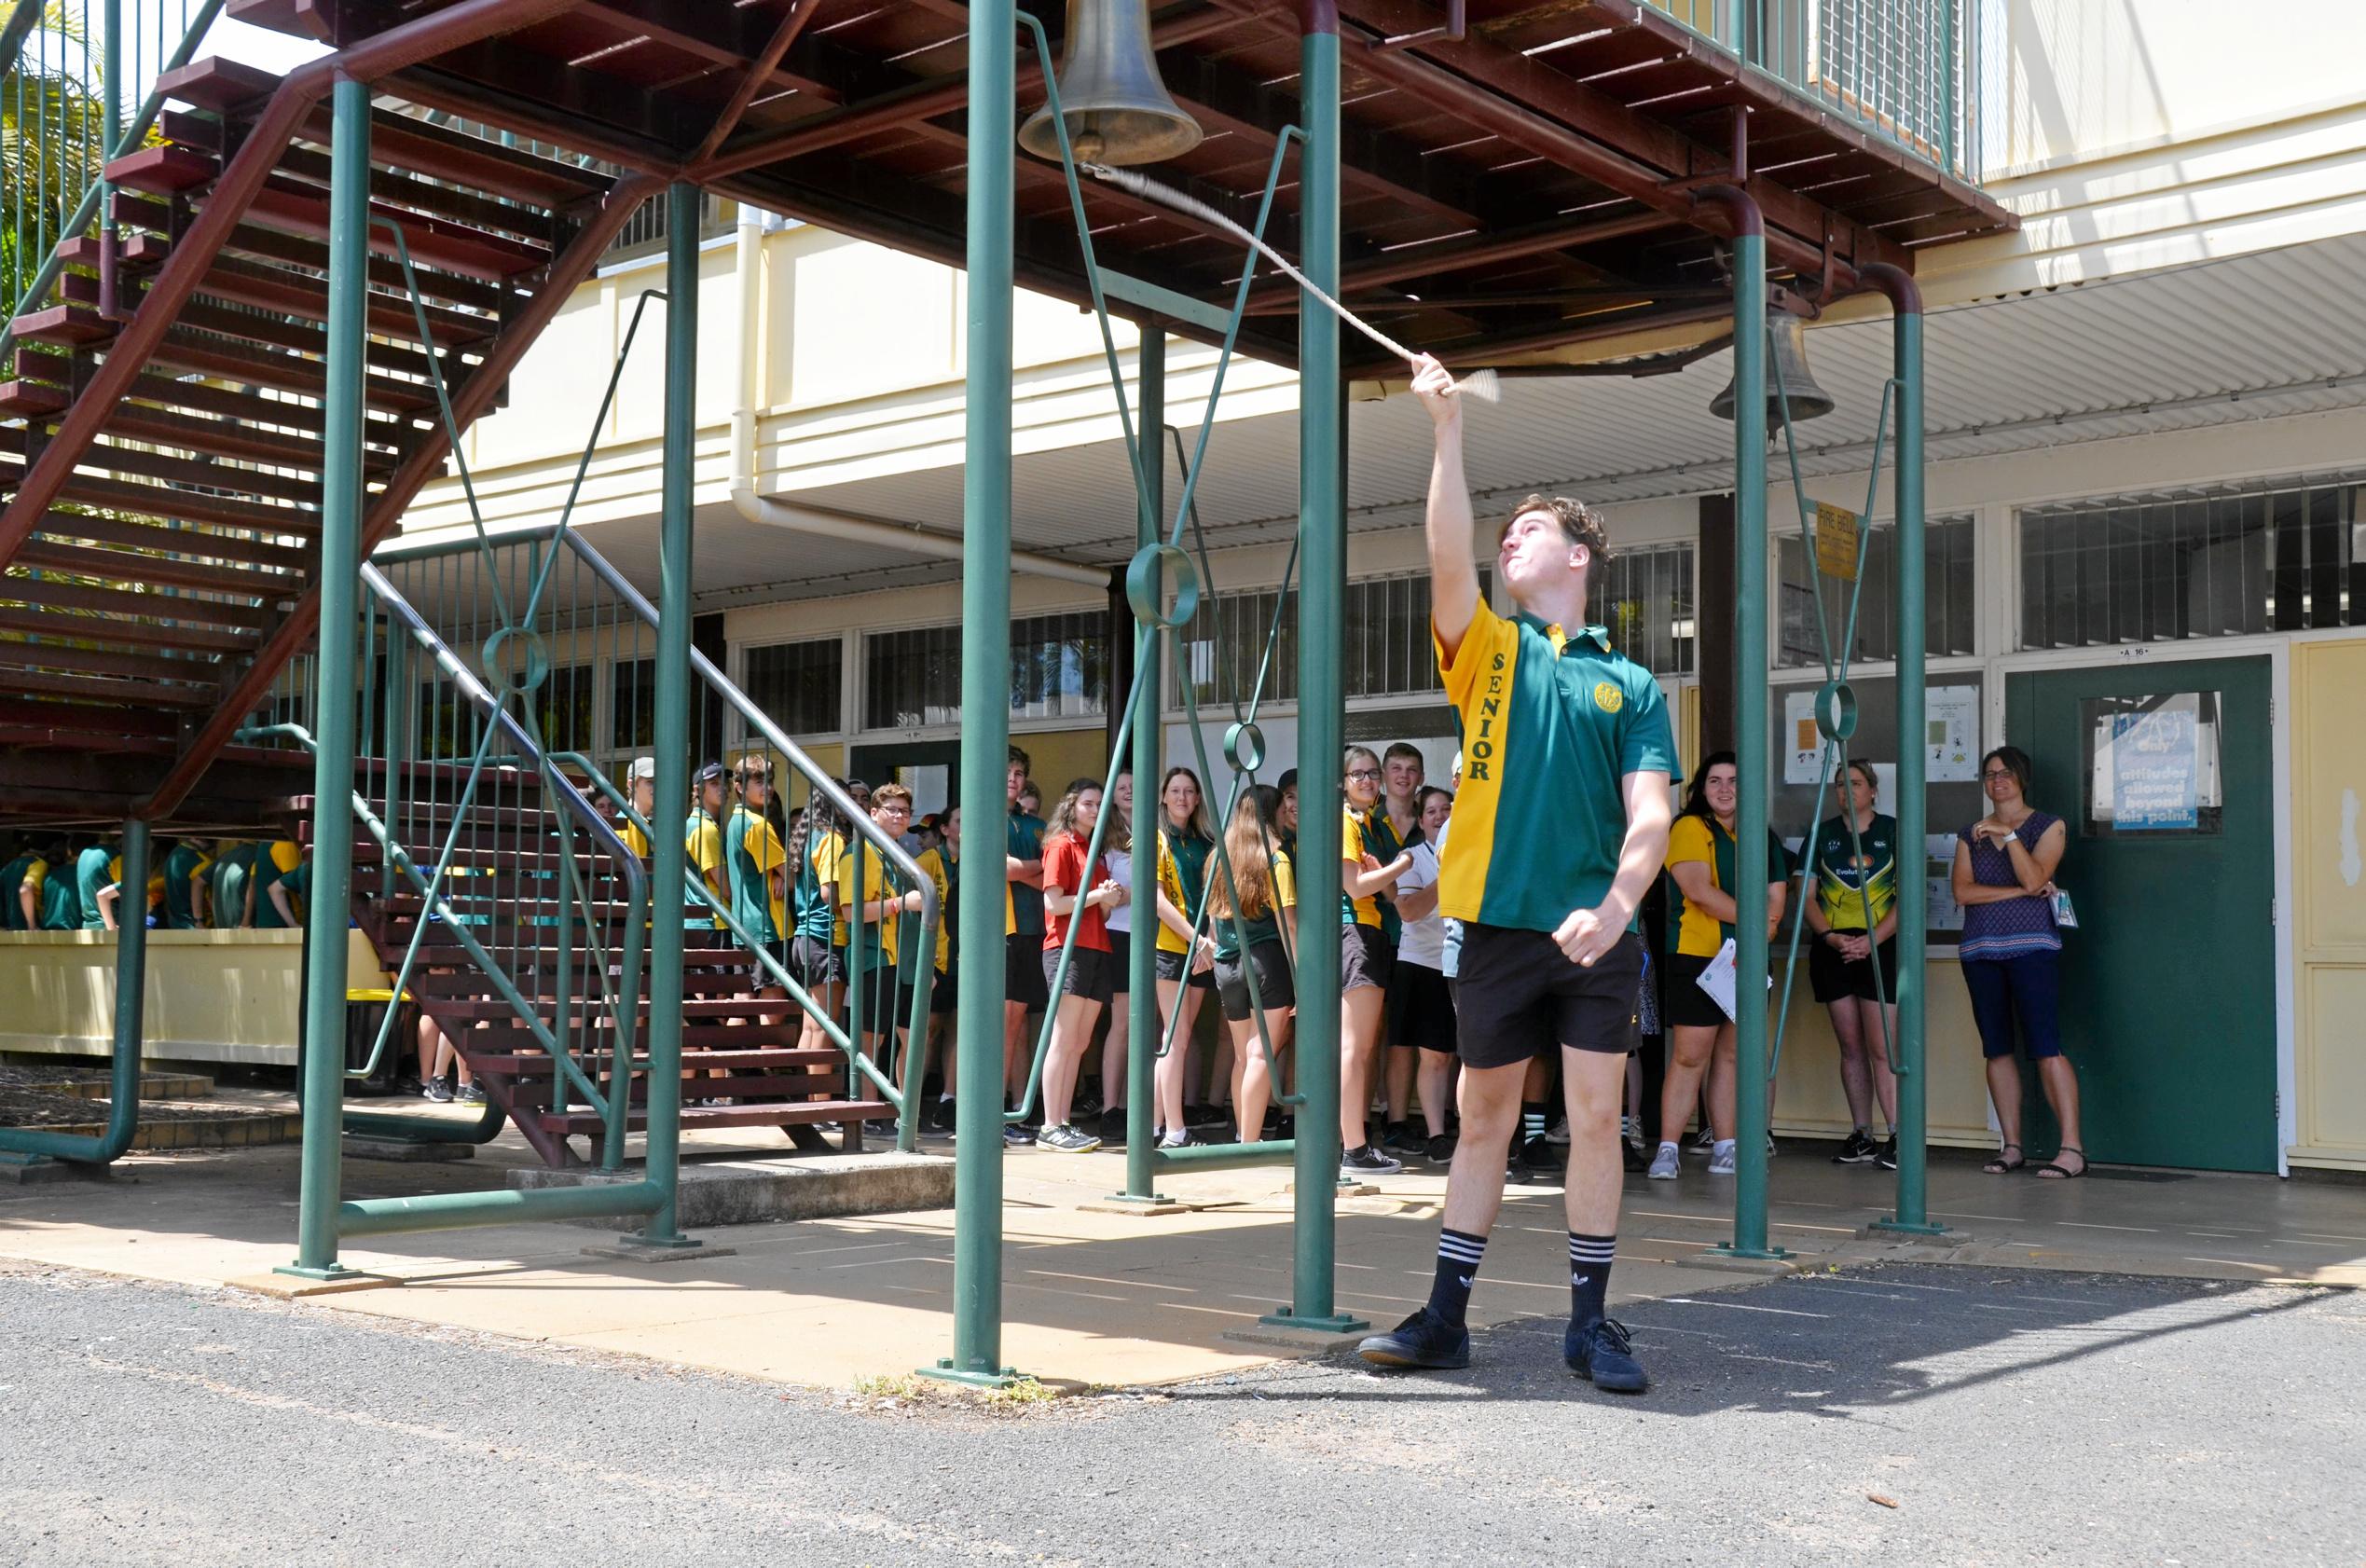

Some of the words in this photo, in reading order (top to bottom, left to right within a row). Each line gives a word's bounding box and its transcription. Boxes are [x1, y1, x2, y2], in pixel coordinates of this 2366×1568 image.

[1819, 509, 1836, 530] FIRE
[1837, 515, 1855, 536] BELL
[1469, 653, 1505, 780] SENIOR
[2120, 766, 2188, 780] attitudes
[2124, 780, 2185, 794] allowed
[2125, 794, 2183, 810] beyond
[2116, 810, 2143, 823] this
[2148, 809, 2194, 825] point.
